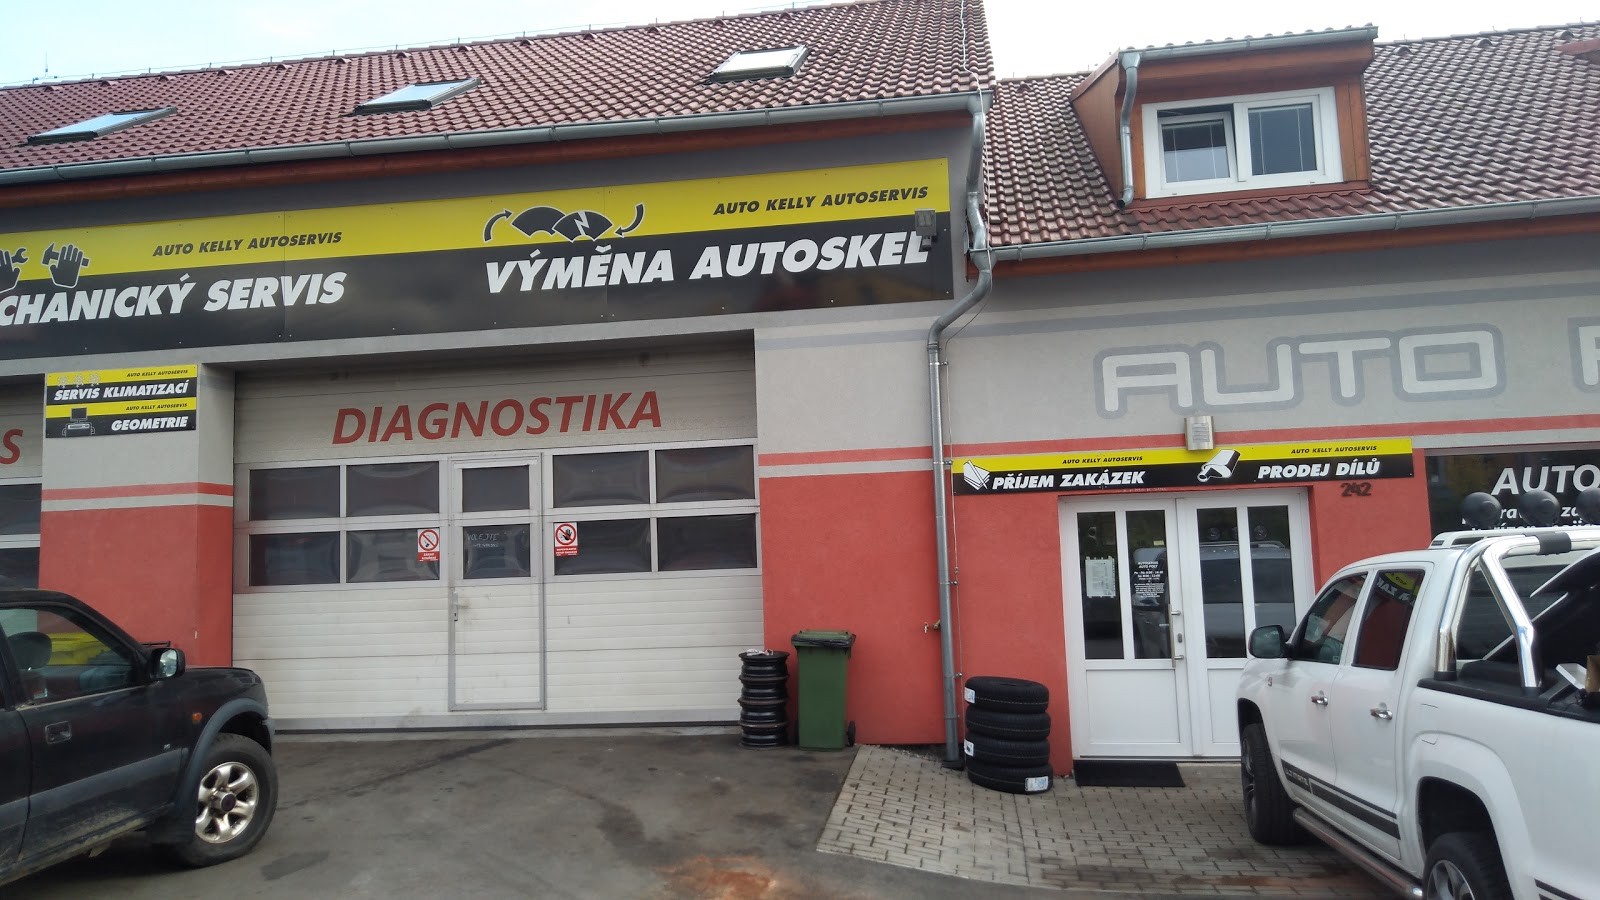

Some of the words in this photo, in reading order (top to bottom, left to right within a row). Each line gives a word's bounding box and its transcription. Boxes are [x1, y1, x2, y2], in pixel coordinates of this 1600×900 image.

[712, 200, 760, 216] AUTO
[765, 195, 816, 211] KELLY
[820, 186, 929, 207] AUTOSERVIS
[152, 243, 194, 257] AUTO
[198, 238, 243, 253] KELLY
[247, 231, 342, 249] AUTOSERVIS
[484, 244, 674, 294] VÝMĚNA
[688, 230, 929, 280] AUTOSKEL
[203, 271, 348, 312] SERVIS
[1095, 323, 1506, 419] AUTO
[53, 387, 100, 401] SERVIS
[103, 379, 190, 398] KLIMATIZACÍ
[111, 416, 189, 432] GEOMETRIE
[332, 390, 662, 445] DIAGNOSTIKA
[1103, 455, 1143, 463] AUTOSERVIS
[1257, 463, 1331, 479] PRODEJ
[1335, 457, 1381, 476] DÍLŮ
[992, 472, 1055, 490] PŘÍJEM
[1059, 469, 1146, 487] ZAKÁZEK
[1340, 481, 1372, 498] 242
[1490, 464, 1600, 496] AUTO
